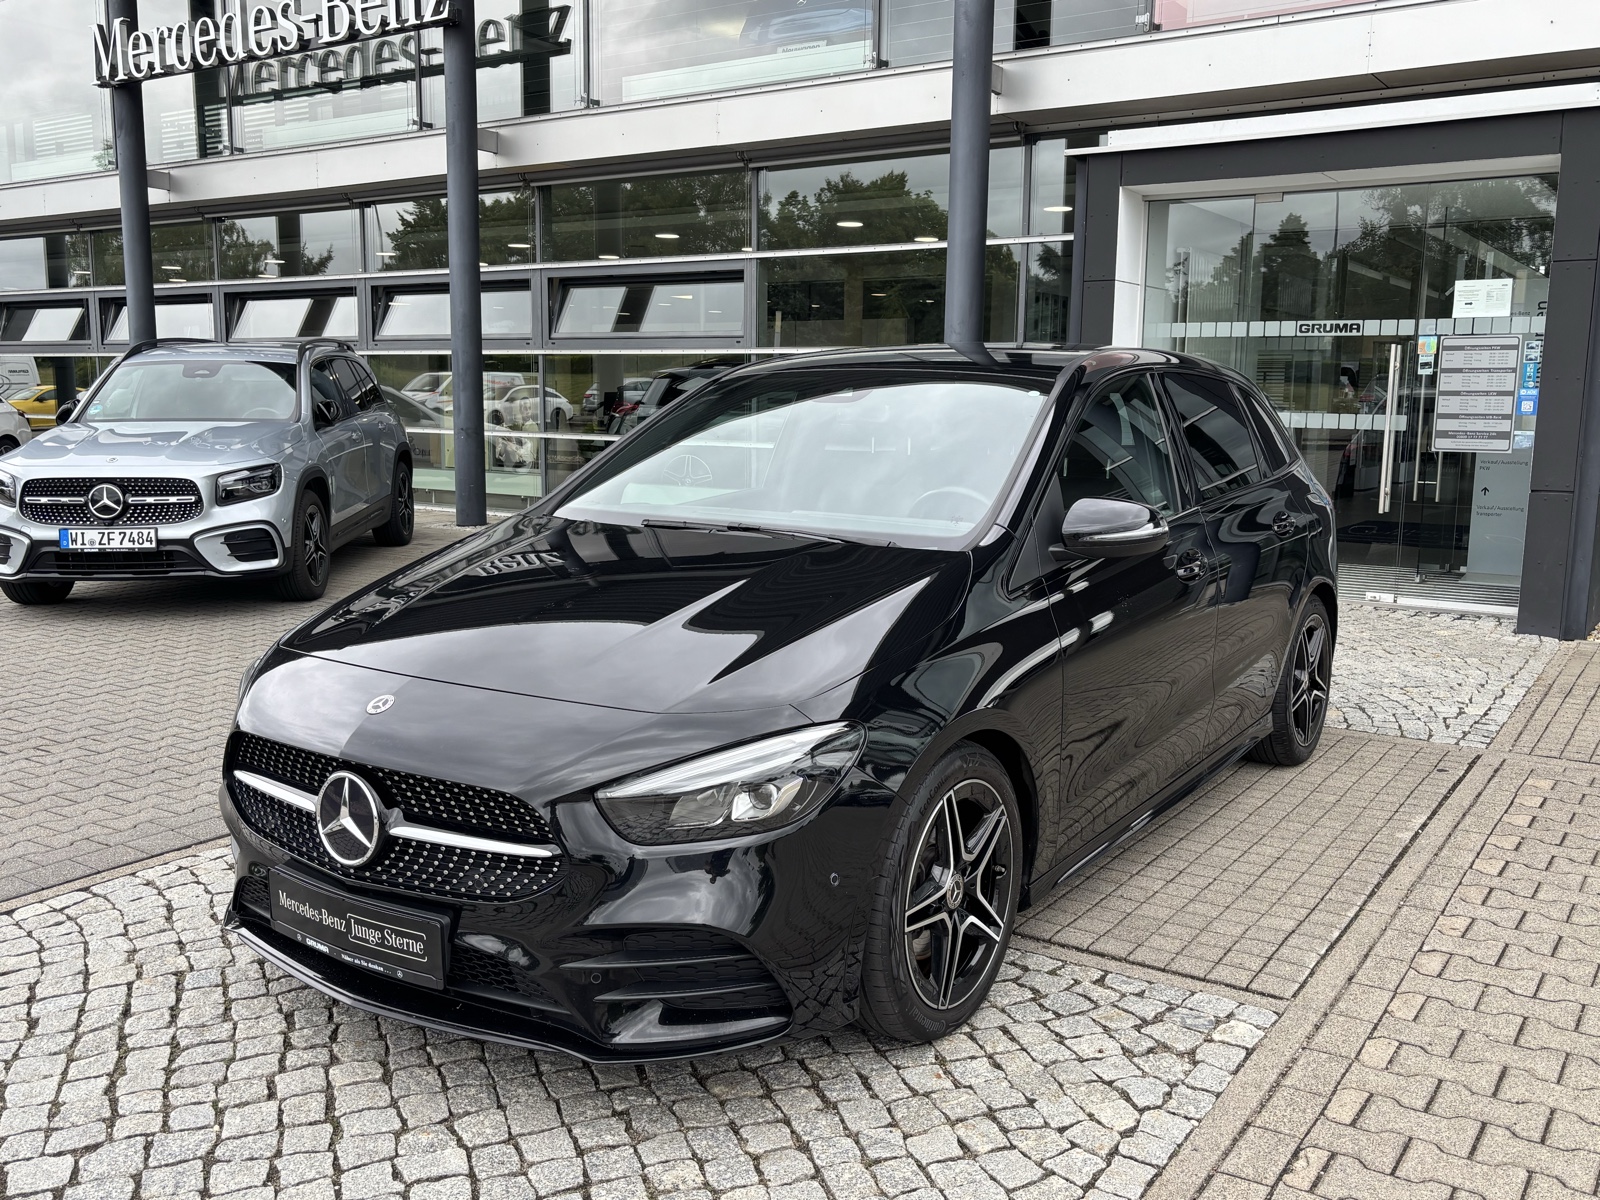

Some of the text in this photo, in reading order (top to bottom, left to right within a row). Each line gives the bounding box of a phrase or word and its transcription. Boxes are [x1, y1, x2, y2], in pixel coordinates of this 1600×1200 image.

[1298, 323, 1360, 334] GRUMA
[70, 532, 86, 546] WI
[98, 532, 115, 546] ZF
[119, 532, 153, 546] 7484
[278, 890, 424, 954] Mercedes-Benz Junge Sterne
[306, 938, 329, 954] GRUMA
[909, 1006, 946, 1034] Continental
